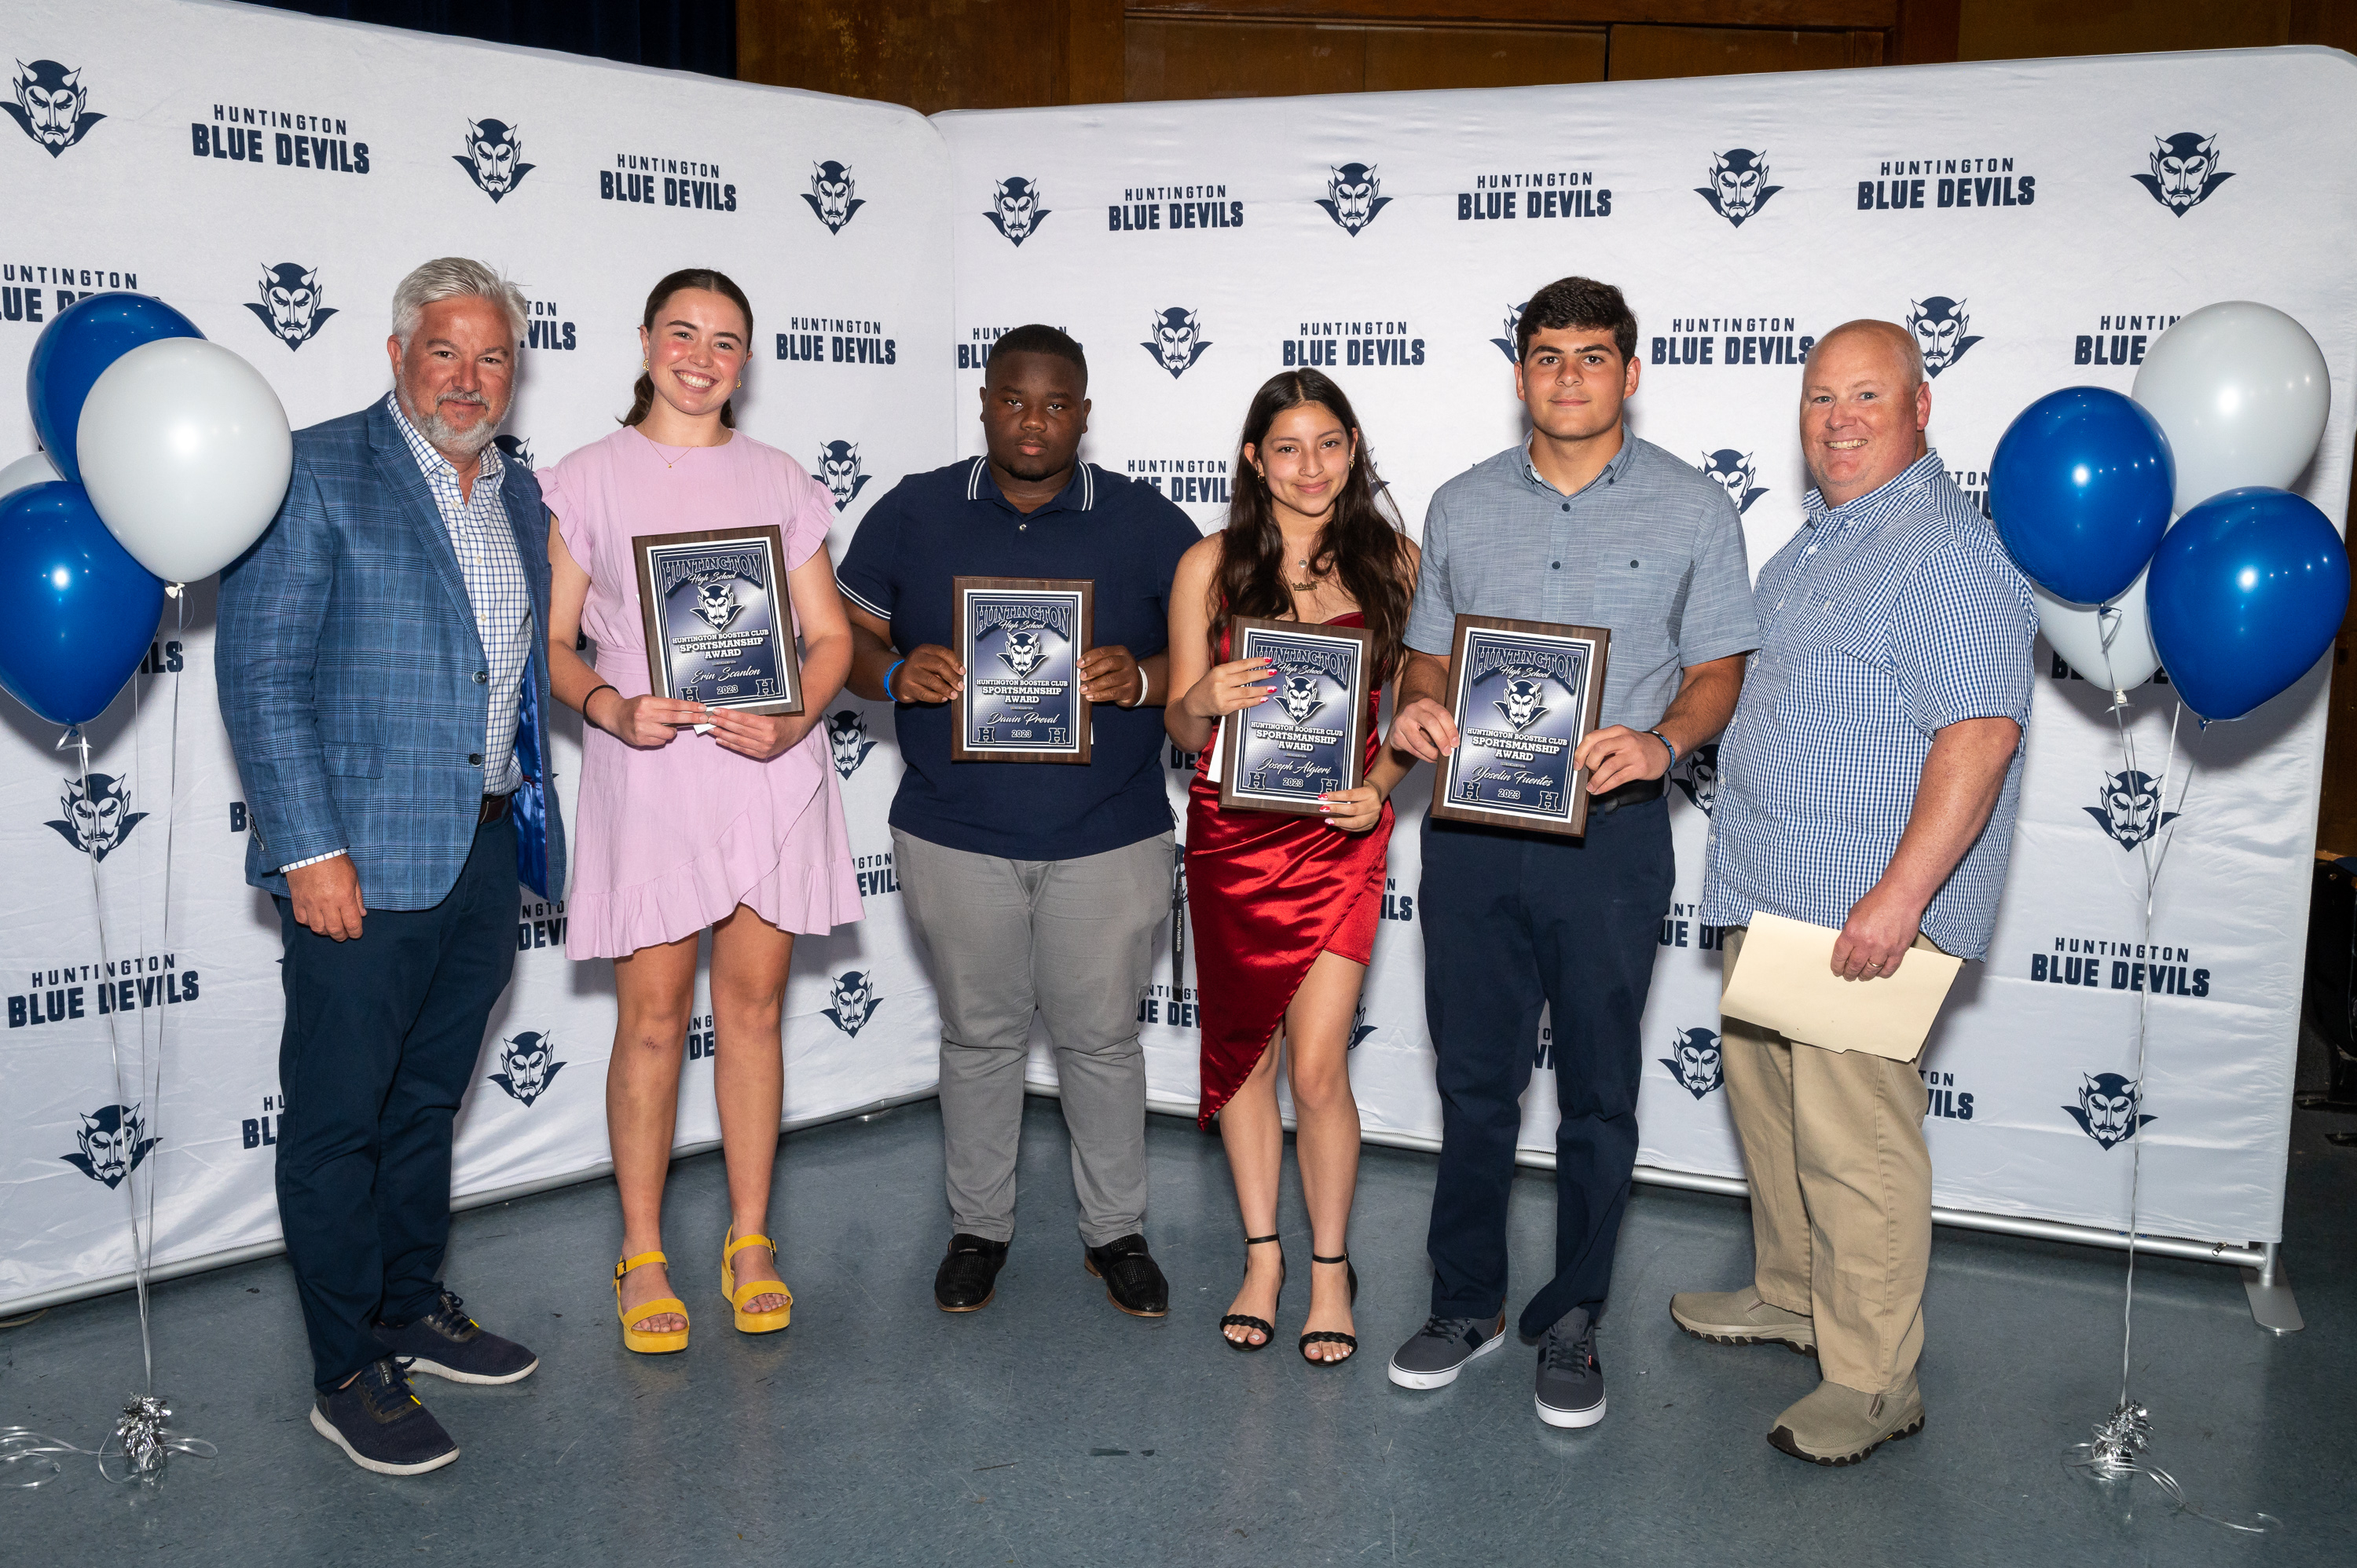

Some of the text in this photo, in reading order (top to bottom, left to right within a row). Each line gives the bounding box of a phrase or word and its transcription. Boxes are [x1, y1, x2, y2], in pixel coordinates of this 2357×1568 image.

[214, 104, 346, 136] HUNTINGTON
[191, 123, 370, 174] BLUE DEVILS
[617, 153, 720, 179] HUNTINGTON
[1880, 157, 2014, 176] HUNTINGTON
[1477, 171, 1593, 189] HUNTINGTON
[599, 170, 737, 212] BLUE DEVILS
[1125, 185, 1226, 201] HUNTINGTON
[1857, 175, 2036, 211] BLUE DEVILS
[1457, 189, 1612, 221] BLUE DEVILS
[1108, 201, 1244, 232] BLUE DEVILS
[2, 264, 137, 290] UNTINGTON
[0, 287, 43, 323] UE
[791, 317, 881, 335] HUNTINGTON
[1300, 321, 1406, 335] HUNTINGTON
[1673, 317, 1795, 332] HUNTINGTON
[520, 319, 577, 350] VILS
[775, 333, 896, 365] BLUE DEVILS
[958, 344, 994, 369] BLU
[1283, 339, 1425, 366] BLUE DEVILS
[1651, 335, 1815, 365] BLUE DEVILS
[2074, 335, 2147, 365] BLUE
[1127, 460, 1227, 473] HUNTINGTON
[1171, 476, 1235, 504] DEVIL
[662, 554, 762, 592] HUNTINGTON
[687, 571, 738, 585] High School
[976, 604, 1070, 637] HUNTINGTON
[999, 620, 1047, 632] High School
[672, 628, 769, 644] HUNTINGTON BOOSTER CLUB
[679, 637, 764, 653] SPORTSMANSHIP
[704, 649, 742, 659] AWARD
[691, 665, 761, 684] Erin Scanlon
[1277, 662, 1325, 675] High School
[1473, 646, 1579, 690] HUNTINGTON
[1499, 665, 1552, 680] High School
[717, 685, 739, 694] 2023
[982, 686, 1062, 695] SPORTSMANSHIP
[1024, 712, 1060, 726] Preval
[1250, 721, 1294, 731] HUNTINGTON
[1295, 725, 1325, 735] BOOSTER
[1011, 729, 1032, 738] 2023
[1255, 729, 1337, 745] SPORTSMANSHIP
[1467, 727, 1567, 746] HUNTINGTON BOOSTER CLUB
[1277, 741, 1314, 752] AWARD
[1472, 736, 1560, 755] SPORTSMANSHIP
[1494, 749, 1534, 761] AWARD
[1255, 757, 1332, 778] Joseph Algieri
[1471, 766, 1554, 786] Yoselin Fuentes
[1282, 777, 1304, 787] 2023
[1497, 789, 1521, 800] 2023
[2055, 936, 2189, 963] HUNTINGTON
[31, 953, 175, 987] HUNTINGTON
[2030, 953, 2211, 998] BLUE DEVILS
[7, 970, 200, 1029] BLUE DEVILS
